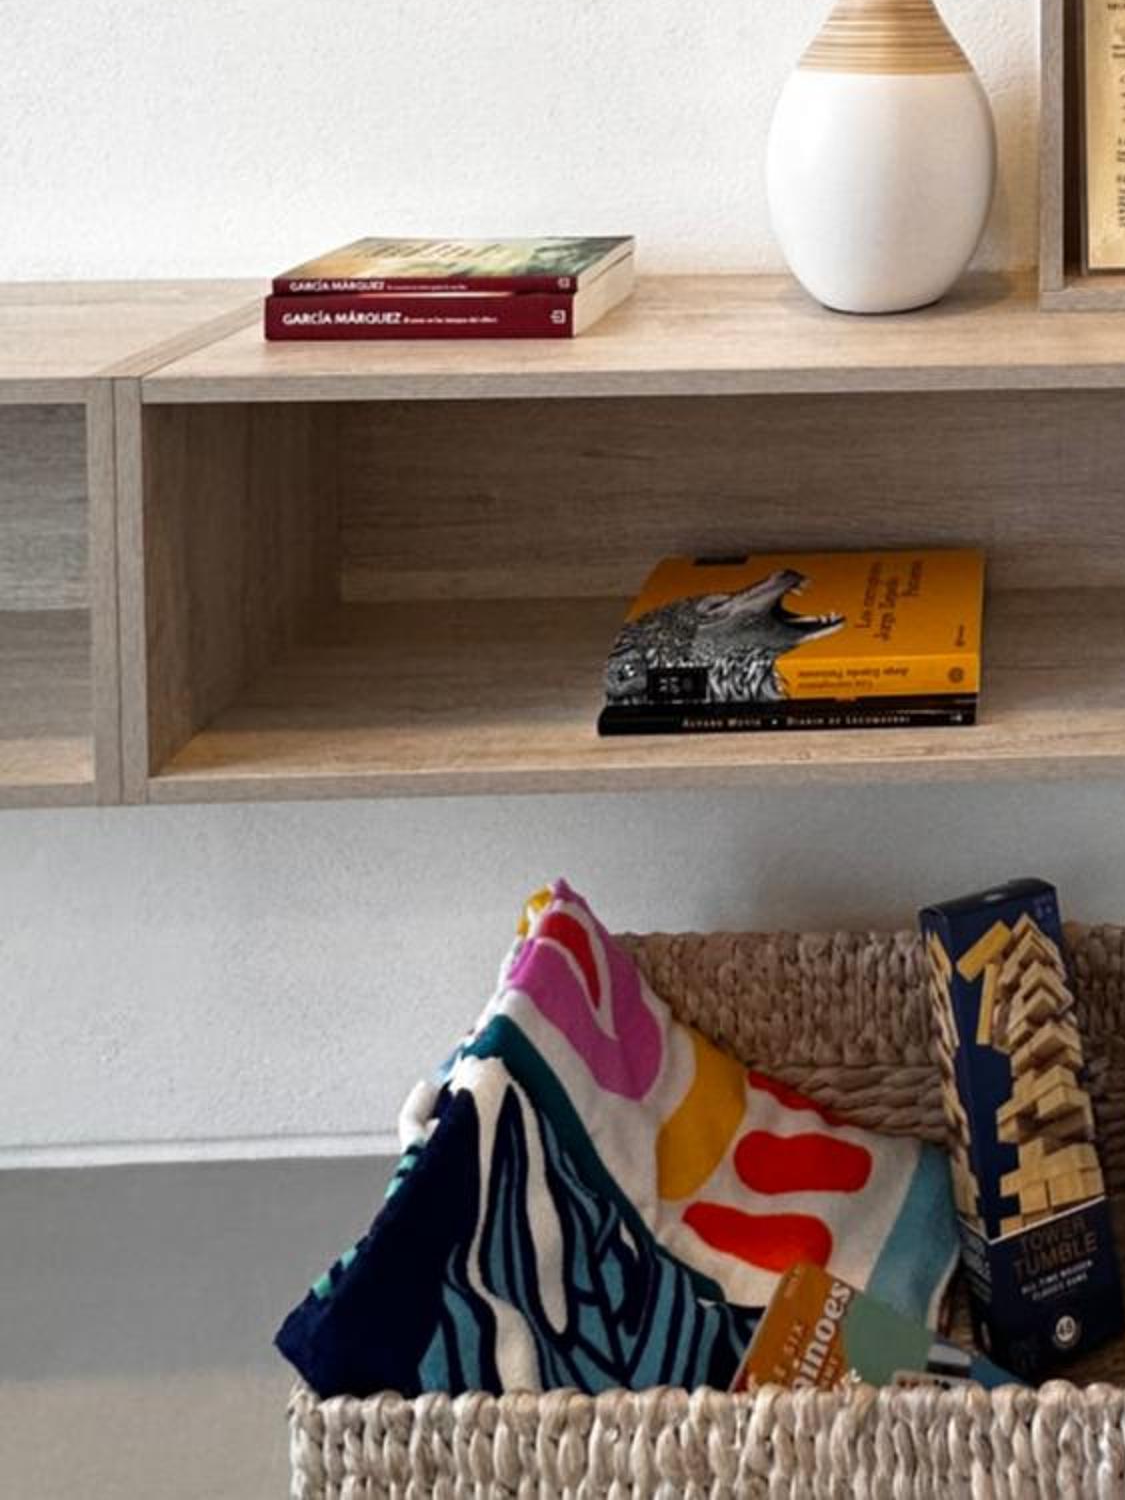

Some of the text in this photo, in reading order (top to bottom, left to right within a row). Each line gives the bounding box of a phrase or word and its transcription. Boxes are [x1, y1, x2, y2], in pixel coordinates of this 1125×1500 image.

[282, 310, 332, 325] GARCÍA
[334, 309, 403, 325] MÁRQUEZ
[1020, 1214, 1087, 1253] TOWER
[1013, 1231, 1098, 1280] TUMBLE
